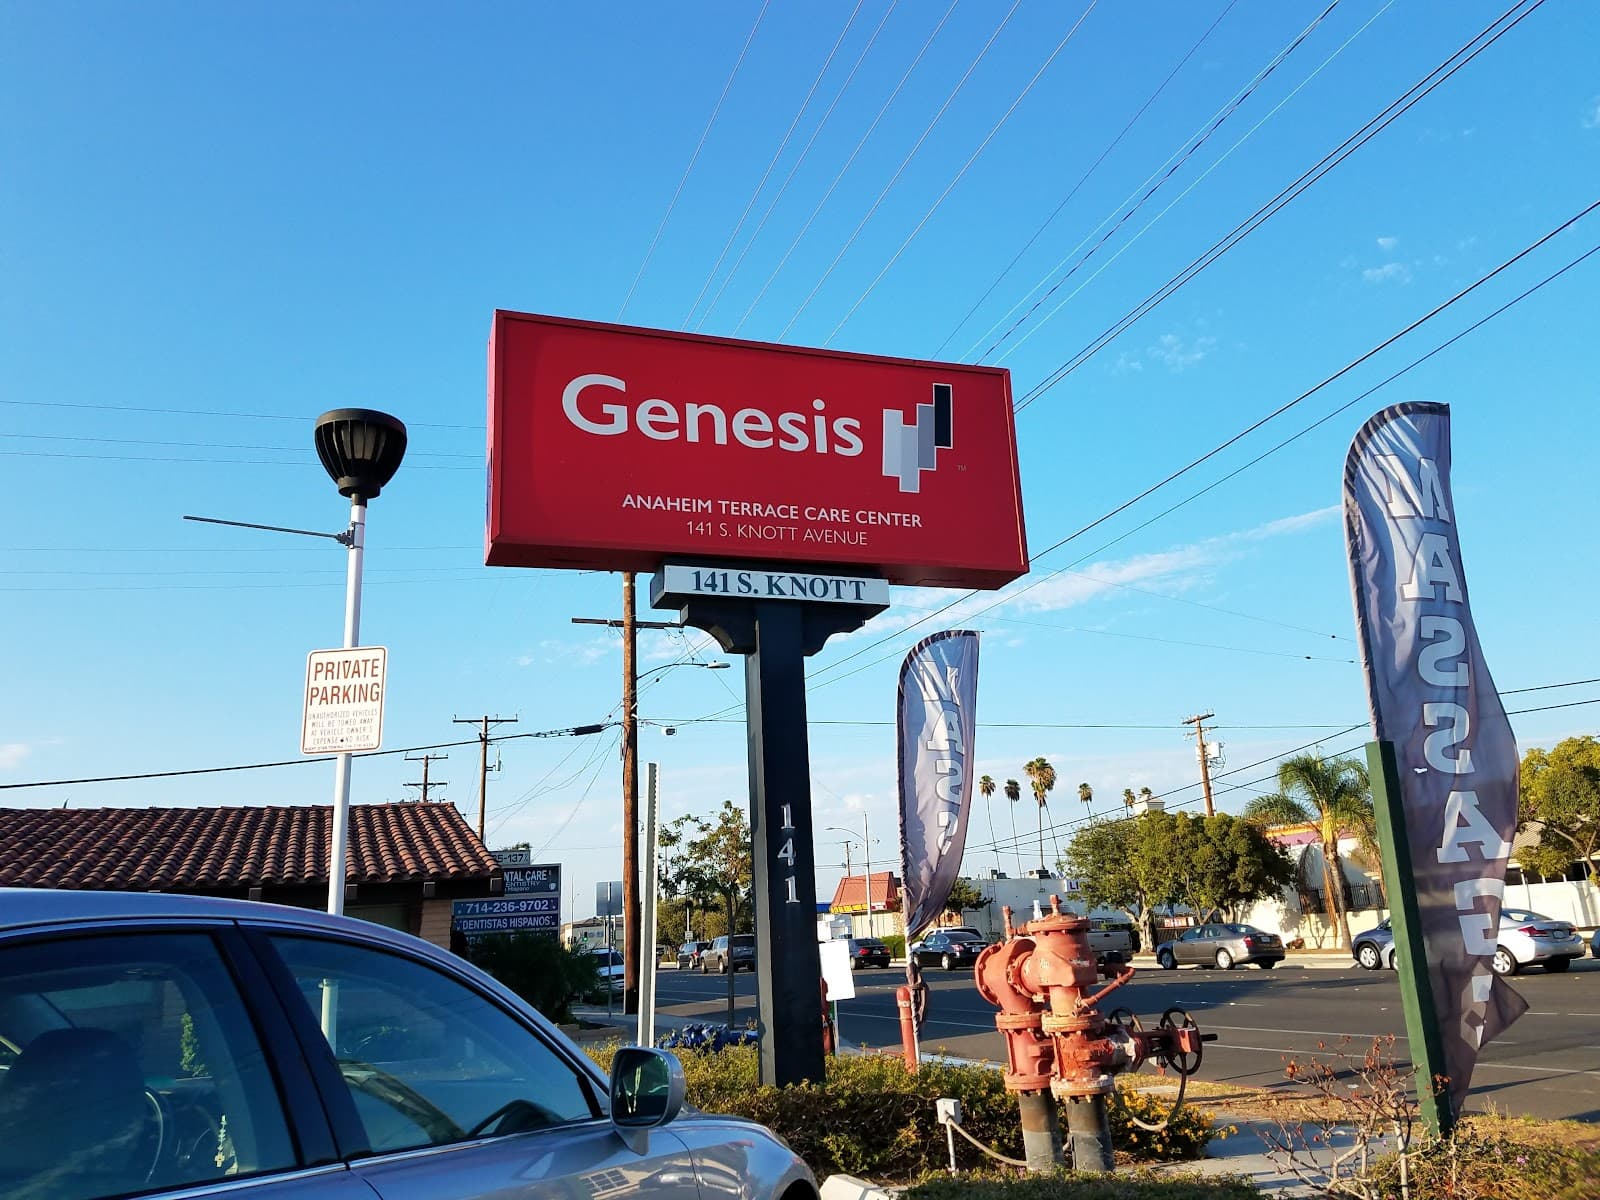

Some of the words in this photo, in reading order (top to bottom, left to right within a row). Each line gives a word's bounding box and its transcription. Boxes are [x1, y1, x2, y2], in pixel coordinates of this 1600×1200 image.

[561, 373, 864, 457] Genesis
[622, 494, 712, 513] ANAHEIM
[718, 500, 799, 519] TERRACE
[804, 507, 850, 523] CARE
[855, 510, 922, 528] CENTER
[687, 520, 713, 536] 141
[719, 522, 731, 537] S.
[737, 524, 798, 541] KNOTT
[803, 528, 868, 546] AVENUE
[691, 570, 730, 593] 141
[737, 572, 759, 594] S.
[765, 574, 866, 601] KNOTT
[314, 658, 380, 681] PRIVATE
[309, 682, 380, 706] PARKING
[340, 736, 353, 744] ND
[777, 802, 801, 904] 141
[504, 871, 524, 882] NTAL
[525, 870, 548, 881] CARE
[505, 880, 541, 888] ENTISTRY
[466, 900, 549, 913] 714-236-9702
[462, 919, 508, 930] DENTISTAS
[510, 916, 550, 928] HISPANOS
